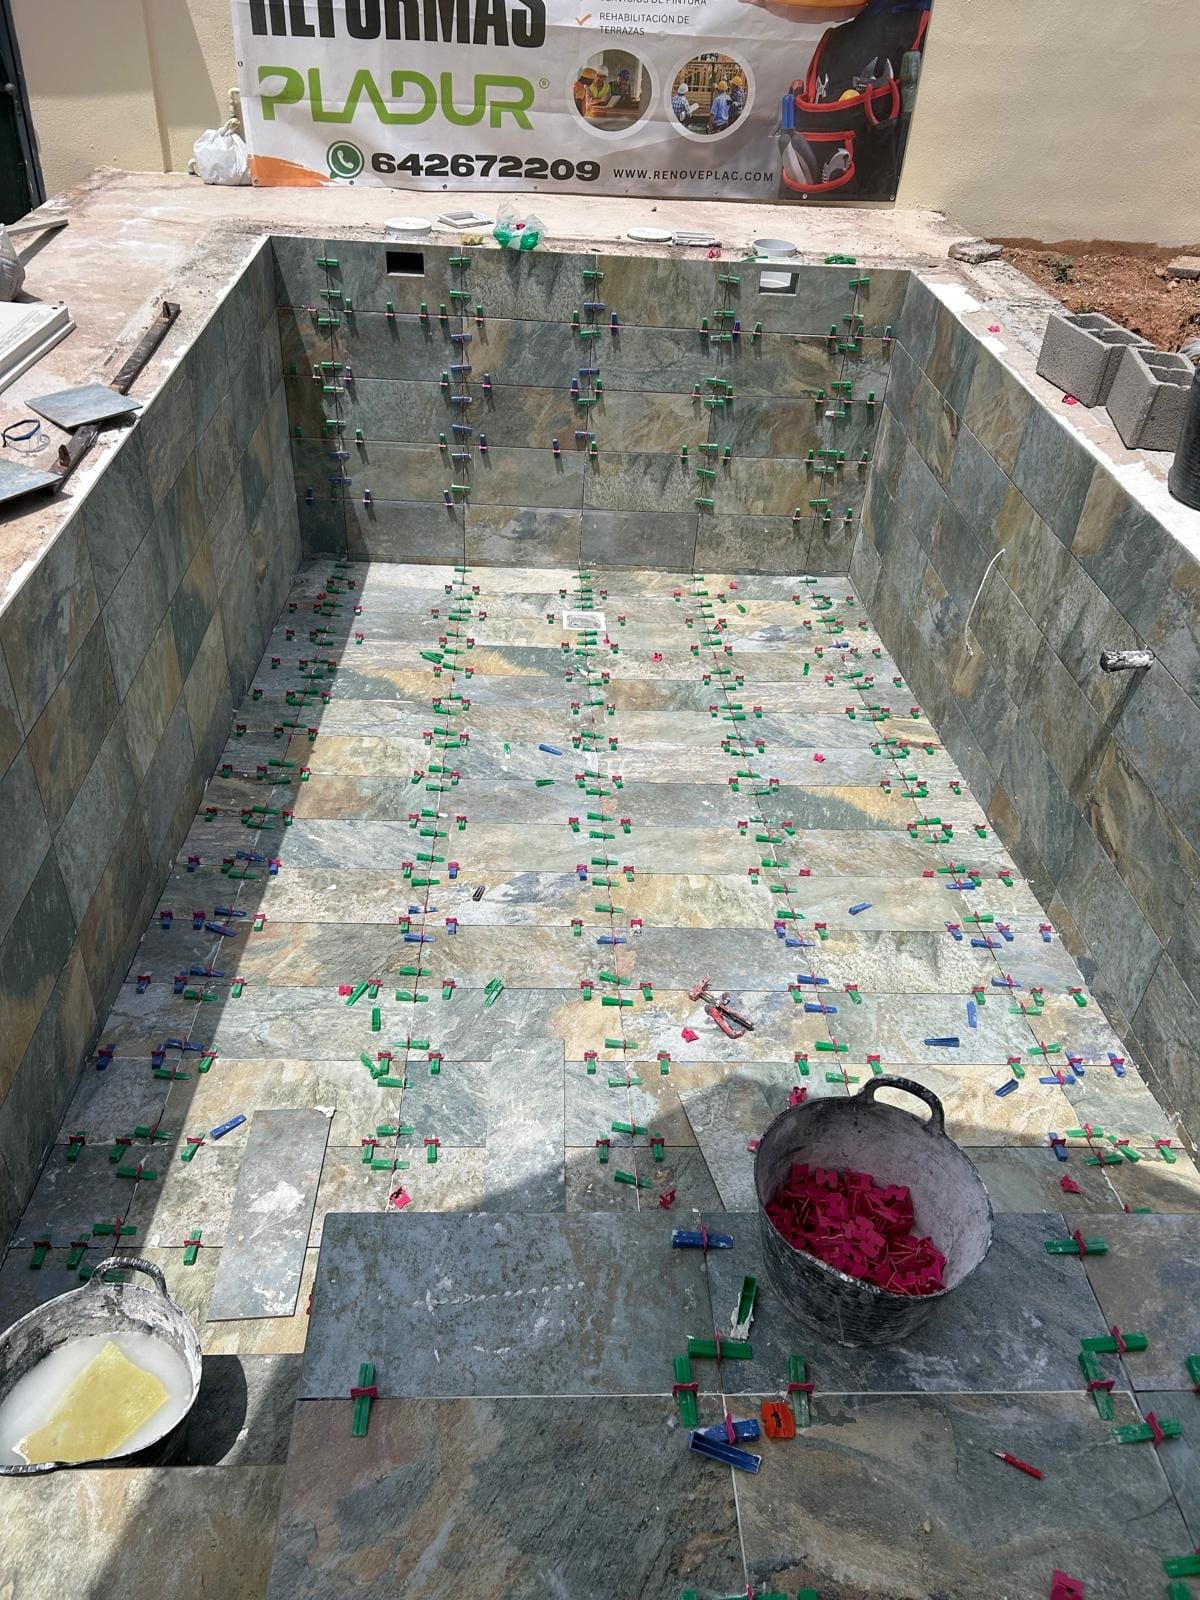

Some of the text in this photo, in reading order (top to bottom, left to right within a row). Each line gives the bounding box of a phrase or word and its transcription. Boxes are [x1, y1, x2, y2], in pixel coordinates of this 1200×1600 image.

[599, 12, 690, 25] REHABILITACIÓN DE
[599, 25, 645, 36] TERRAZAS
[257, 65, 536, 130] PLADUR
[371, 152, 601, 182] 642672209
[613, 168, 774, 182] WWW.RENOVEPLAC.COM
